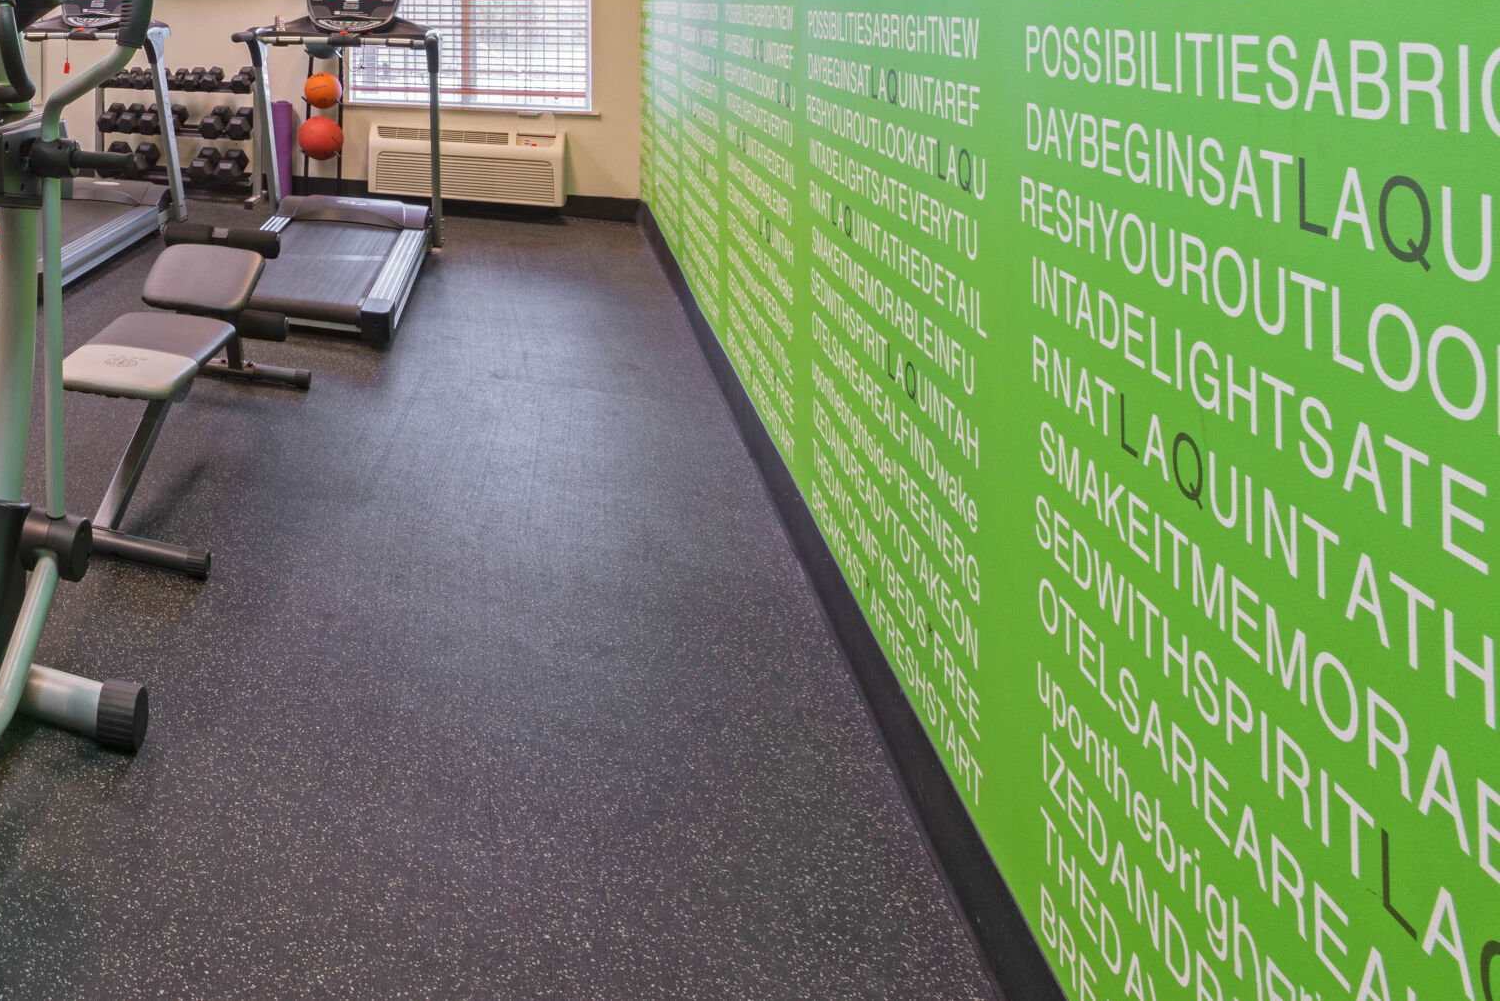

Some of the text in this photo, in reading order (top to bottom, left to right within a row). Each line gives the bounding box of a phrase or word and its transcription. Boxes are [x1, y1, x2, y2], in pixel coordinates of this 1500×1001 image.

[808, 11, 978, 58] POSSIBILITIESABRIGHTNEW
[808, 56, 979, 125] DAYBEGINSATLAQUINTAREF
[807, 95, 985, 199] RESHYOUROUTLOOKATLAQU
[810, 140, 977, 259] INTADELIGHTSATEVERYTU
[810, 181, 986, 336] RNATLAQUINTATHEDETAIL
[812, 226, 973, 393] SMAKEITMEMORABLEINFU
[811, 268, 978, 466] SEDWITHSPIRITLAQUINTAH
[812, 312, 977, 531] OTELSAREAREALFINDwake
[813, 398, 977, 667] IZEDANDREADYTOTAKEON
